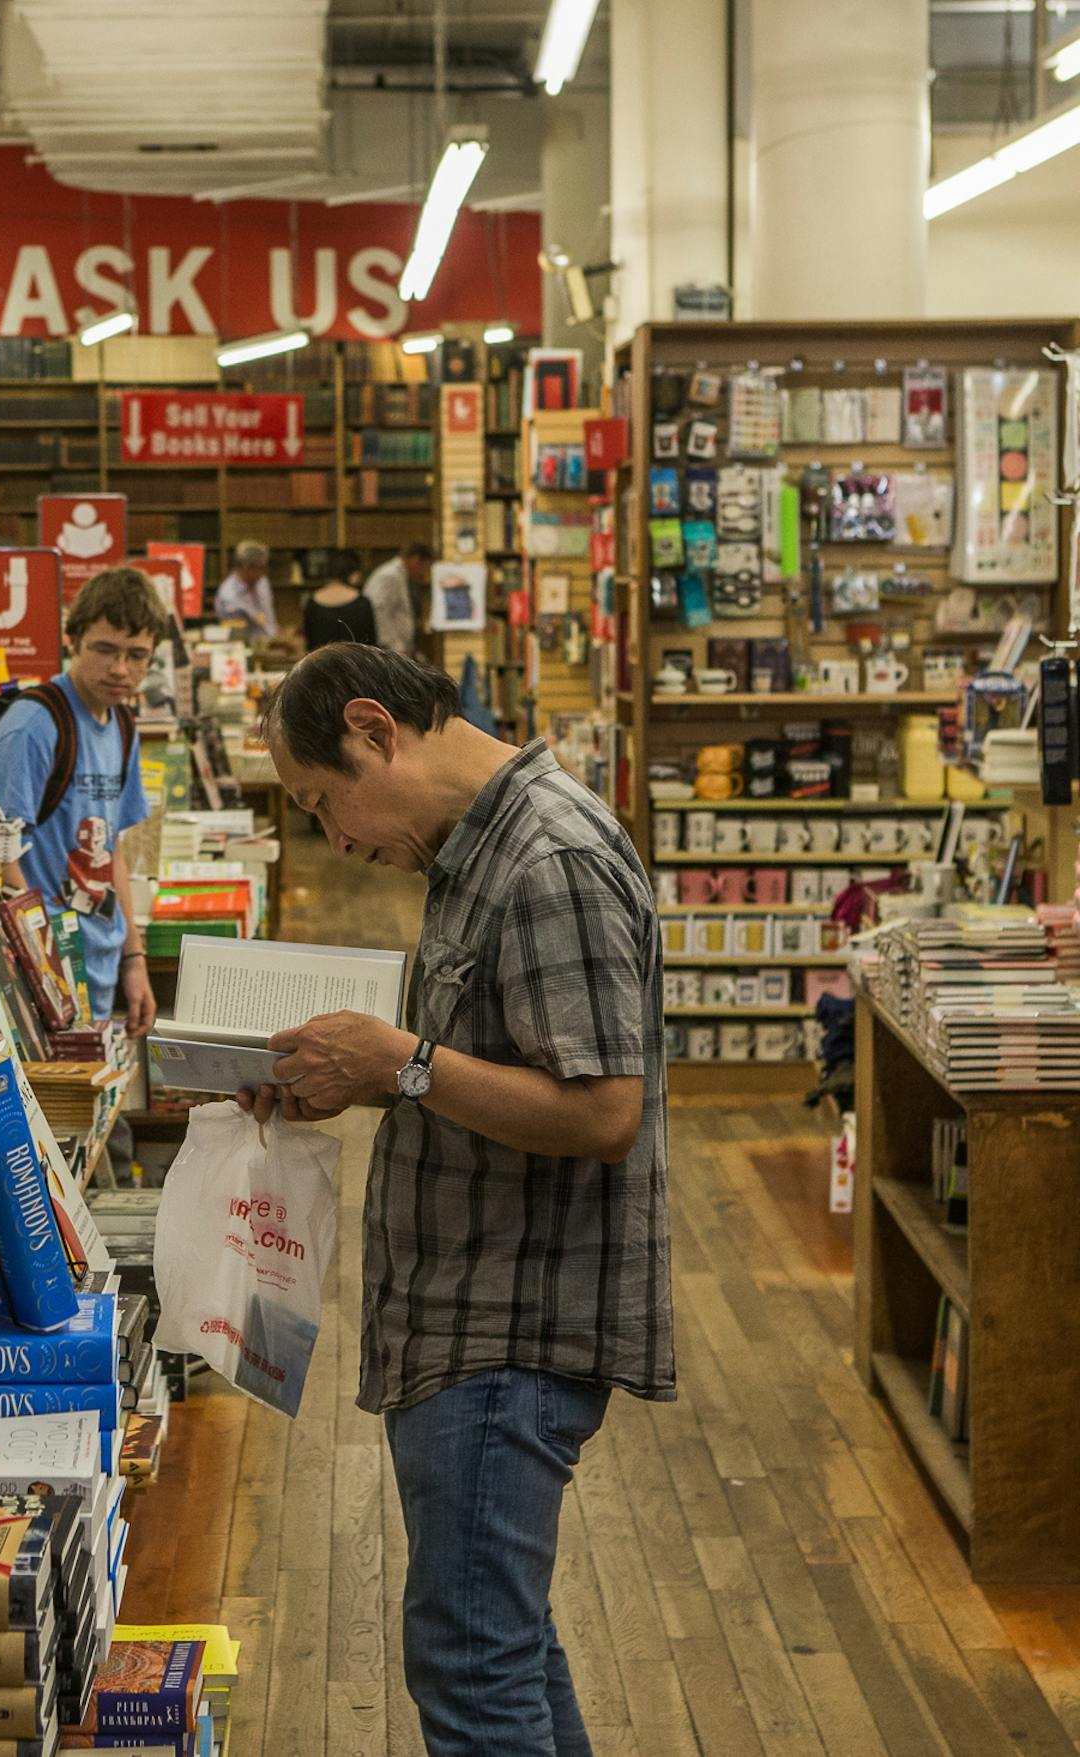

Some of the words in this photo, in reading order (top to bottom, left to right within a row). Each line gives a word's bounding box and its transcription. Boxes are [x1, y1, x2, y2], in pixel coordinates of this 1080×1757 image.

[268, 247, 412, 338] US
[166, 404, 208, 428] Sell
[212, 405, 261, 428] Your
[151, 431, 219, 456] Books
[223, 433, 276, 458] Here
[6, 1141, 55, 1252] ROMANOVS
[116, 1701, 149, 1713] PETER
[102, 1715, 163, 1726] FRANKOPAN
